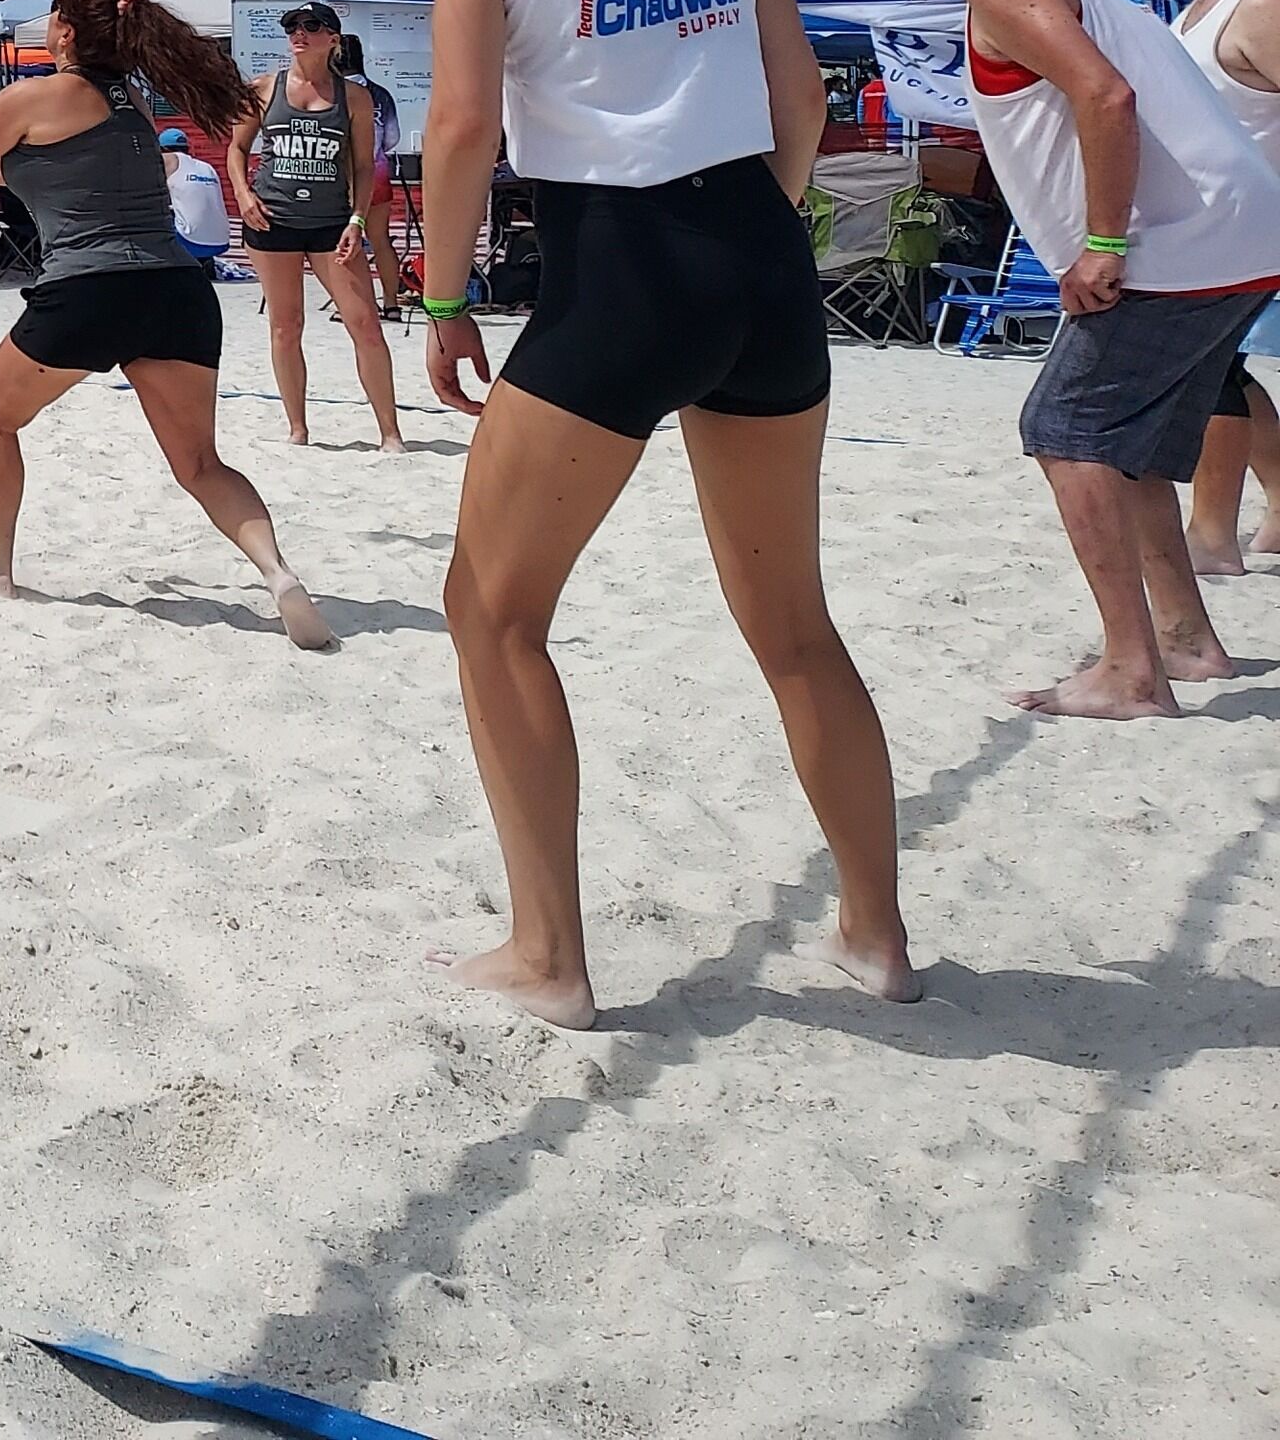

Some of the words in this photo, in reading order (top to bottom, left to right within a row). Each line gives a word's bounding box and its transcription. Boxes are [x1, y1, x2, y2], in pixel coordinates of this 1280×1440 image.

[678, 8, 739, 38] SUPPLY
[291, 119, 321, 135] PCL
[270, 135, 340, 160] WATER
[273, 158, 337, 176] WARRIORS
